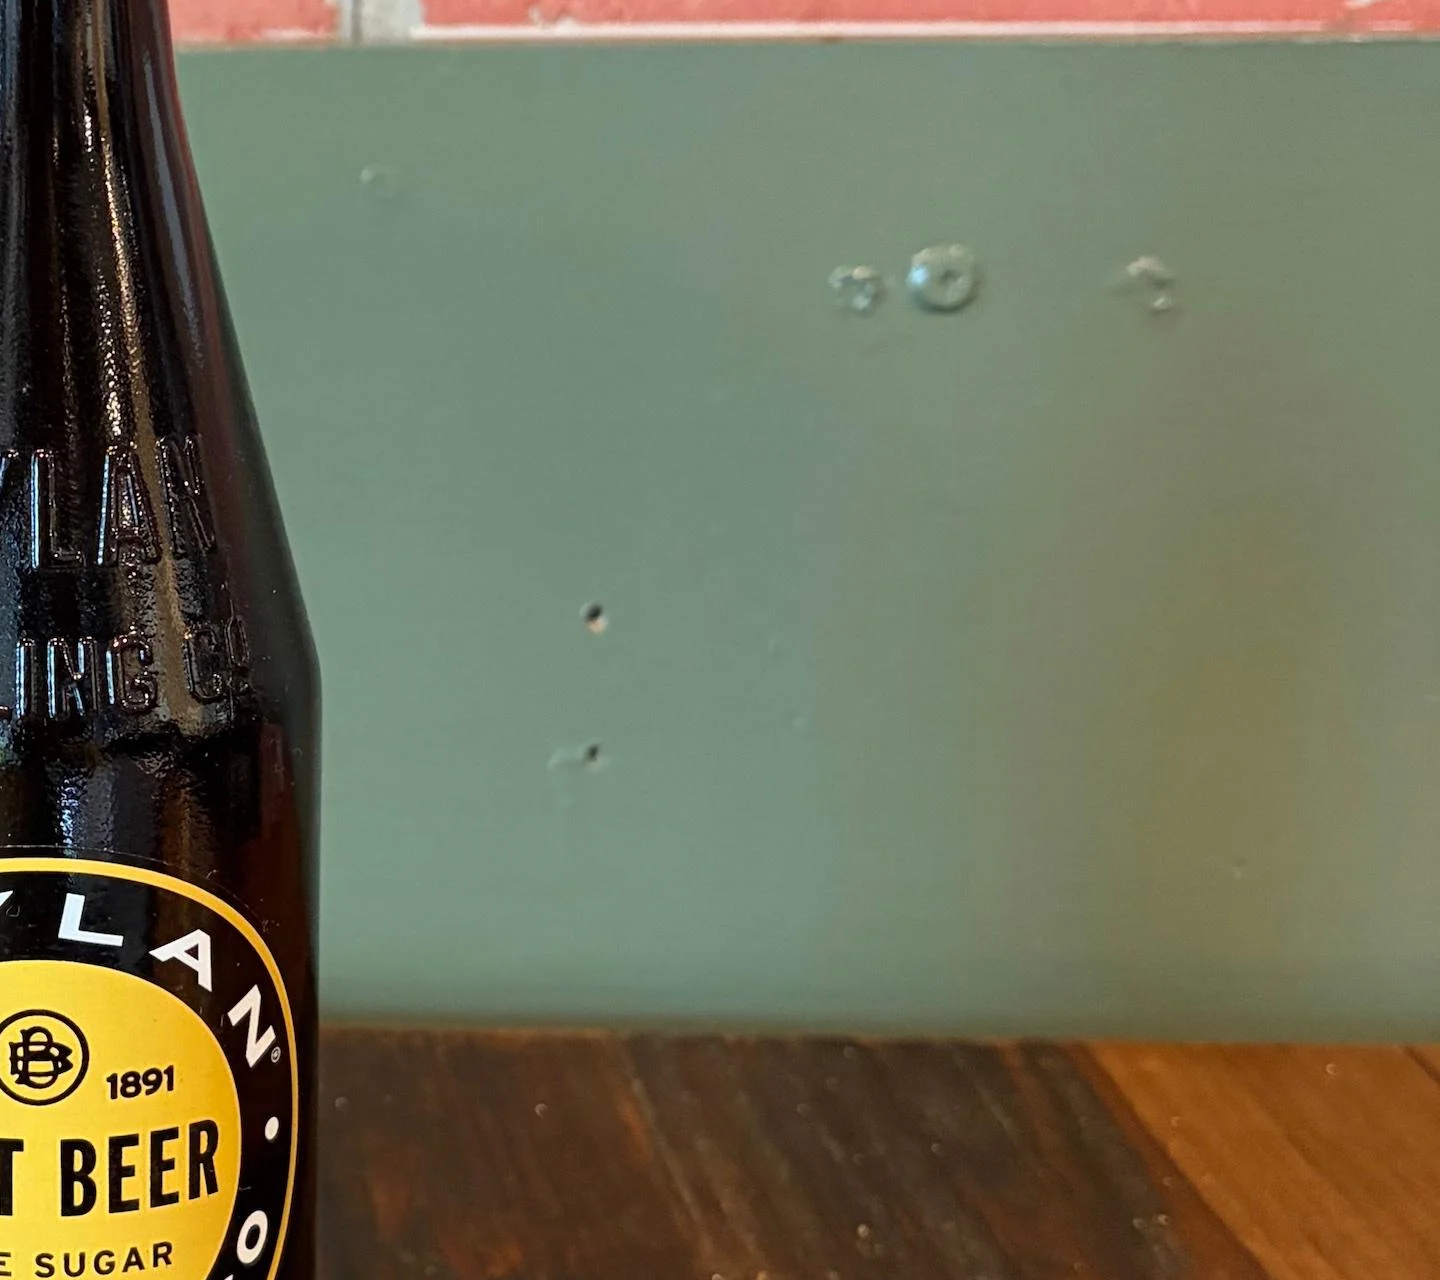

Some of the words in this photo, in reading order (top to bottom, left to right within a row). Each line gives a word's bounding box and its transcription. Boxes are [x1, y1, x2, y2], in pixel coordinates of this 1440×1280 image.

[106, 1065, 175, 1100] 1891
[60, 1119, 220, 1218] BEER
[35, 1241, 174, 1278] SUGAR
